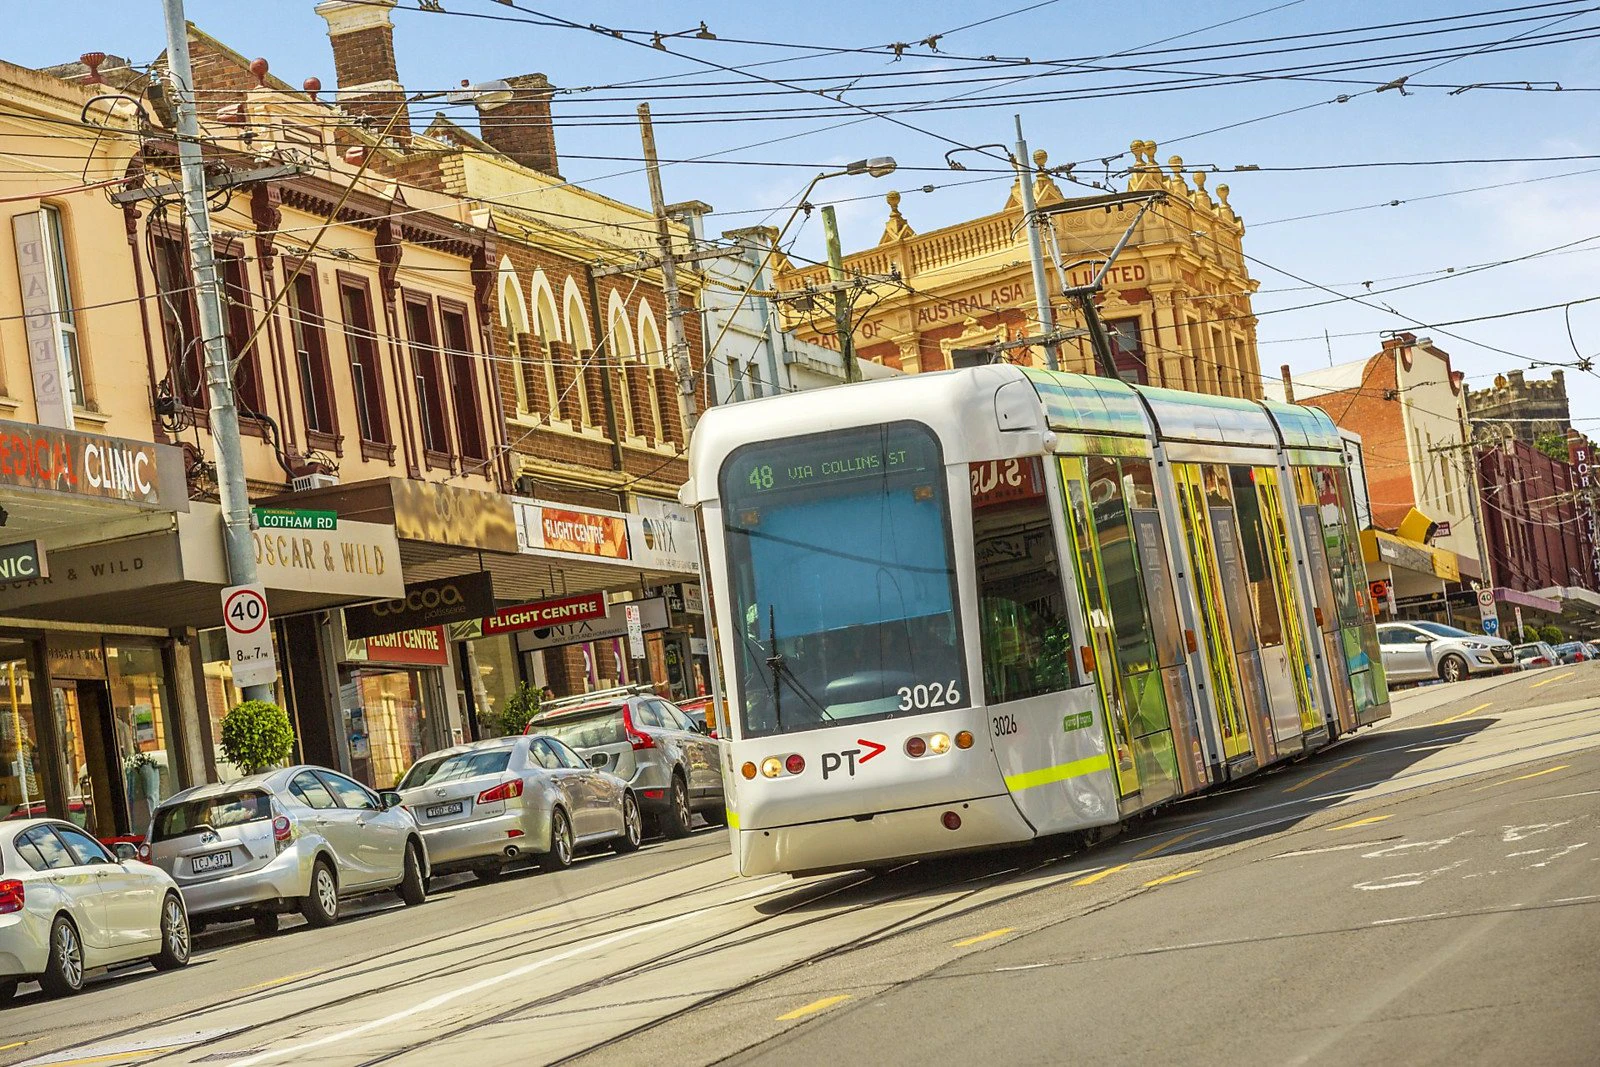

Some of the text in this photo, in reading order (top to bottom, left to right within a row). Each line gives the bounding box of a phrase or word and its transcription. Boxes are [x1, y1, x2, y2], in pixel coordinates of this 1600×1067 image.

[862, 319, 883, 340] OF
[918, 283, 1024, 325] AUSTRALASIA
[85, 443, 151, 495] CLINIC
[749, 450, 906, 490] 48 VIA COLLINS ST
[263, 515, 333, 529] COTHAM RD
[545, 519, 605, 545] FLIGHT CENTRE
[642, 517, 677, 554] ONYX
[67, 557, 144, 580] & WILD
[323, 540, 335, 572] &
[341, 542, 385, 575] WILD
[231, 600, 260, 621] 40
[489, 601, 597, 628] FLIGHT CENTRE
[369, 629, 439, 650] FLIGHT CENTRE
[897, 680, 960, 711] 3026
[992, 713, 1018, 737] 3026
